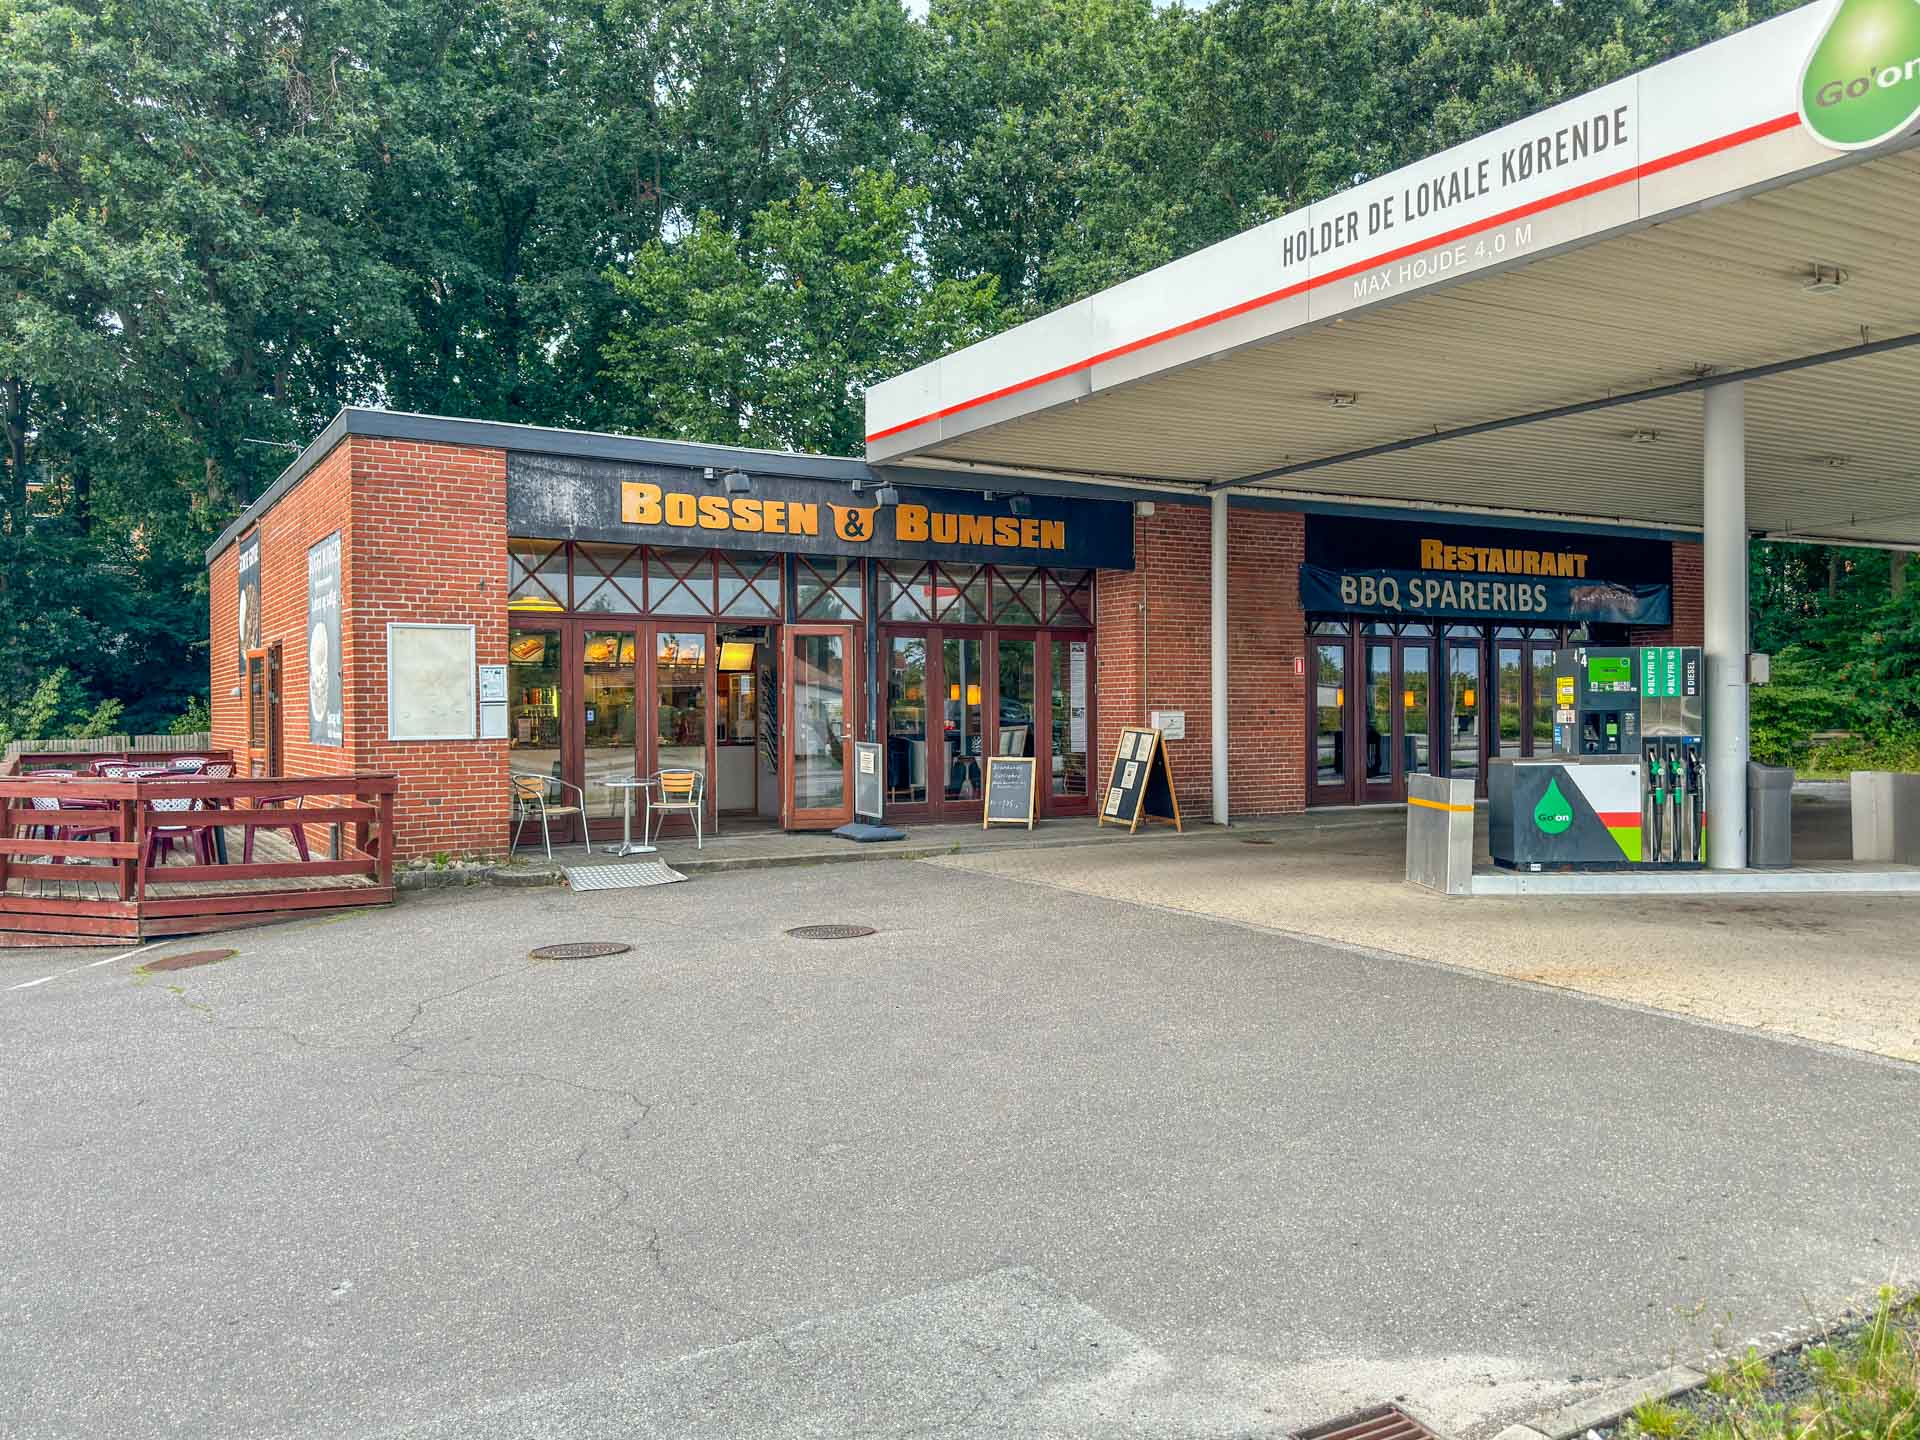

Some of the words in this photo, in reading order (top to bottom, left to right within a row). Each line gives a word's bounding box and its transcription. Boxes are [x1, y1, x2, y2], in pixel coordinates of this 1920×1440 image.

[1283, 211, 1358, 268] HOLDER
[1368, 196, 1395, 236] DE
[1404, 159, 1490, 223] LOKALE
[1501, 105, 1628, 188] KØRENDE
[1352, 269, 1391, 299] MAX
[1399, 244, 1467, 284] HØJDE
[1515, 223, 1533, 246] M
[621, 480, 819, 536] BOSSEN
[843, 508, 865, 538] &
[895, 503, 1065, 550] BUMSEN
[1420, 538, 1588, 578] RESTAURANT
[1340, 575, 1402, 611] BBQ
[1408, 578, 1548, 614] SPARERIBS
[1580, 654, 1588, 668] 4
[1687, 660, 1696, 686] DIESEL
